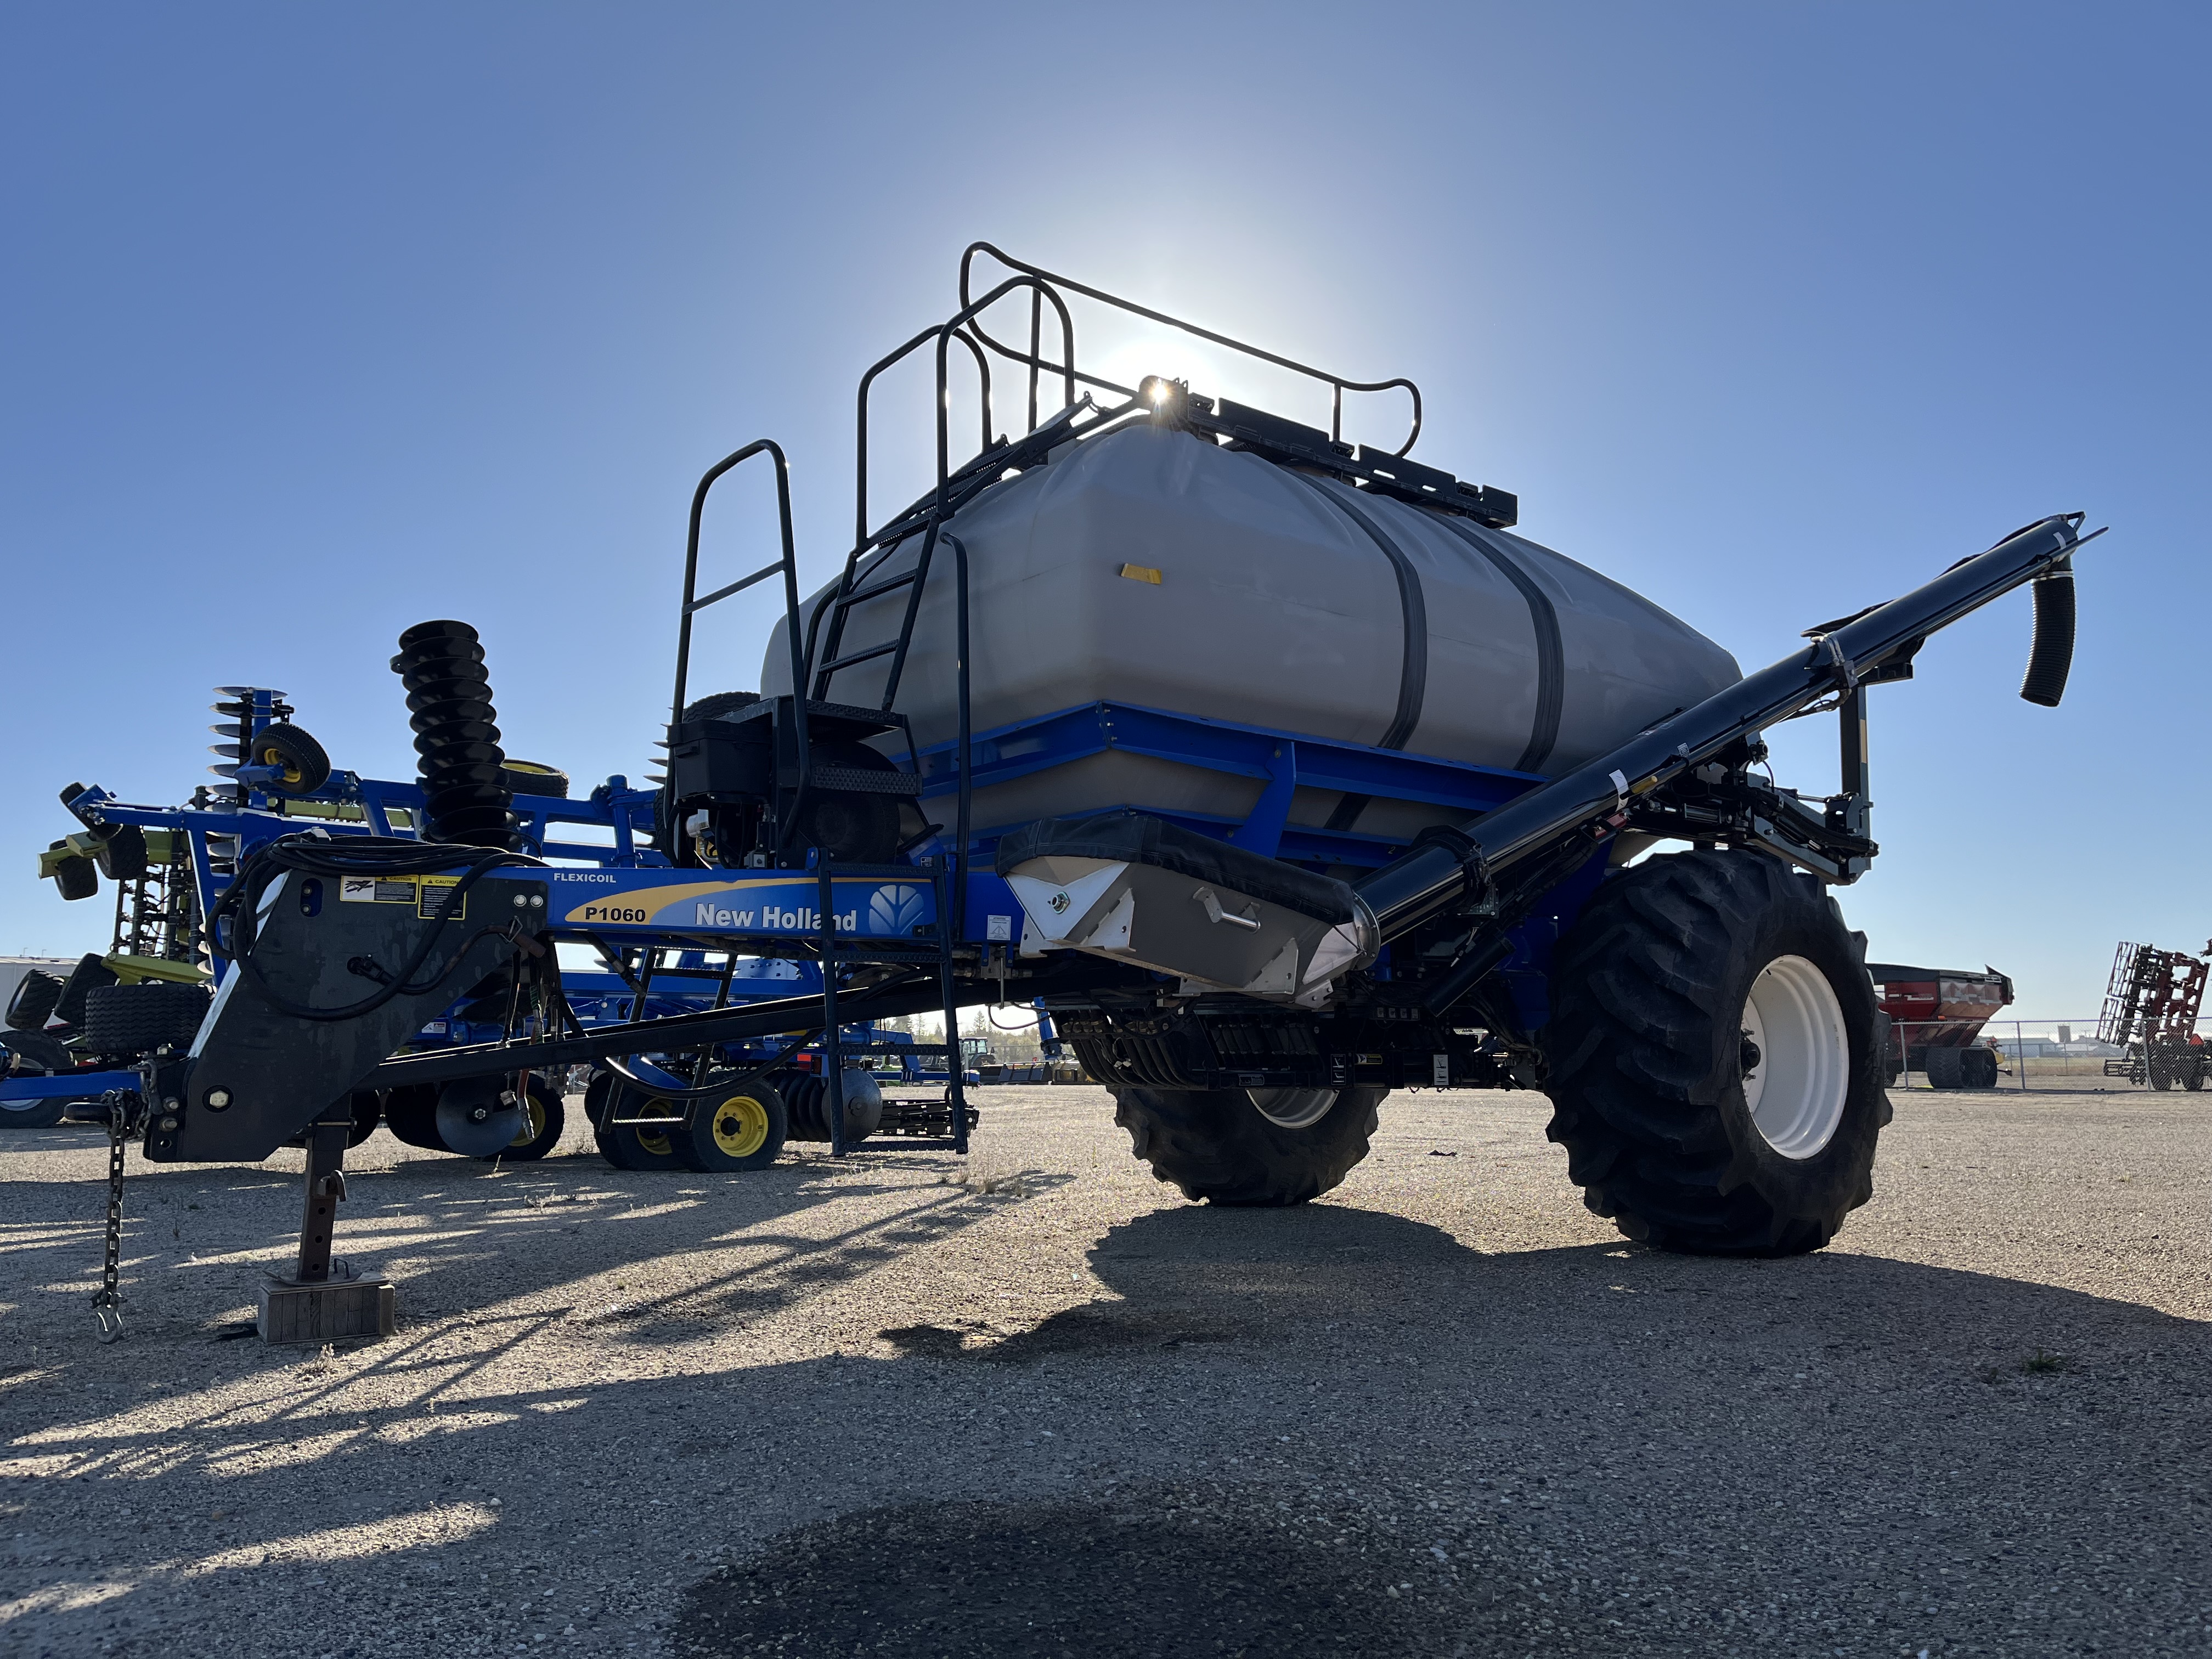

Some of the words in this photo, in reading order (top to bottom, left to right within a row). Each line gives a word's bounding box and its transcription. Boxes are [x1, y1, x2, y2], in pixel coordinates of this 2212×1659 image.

[554, 873, 617, 883] FLEXICOIL
[585, 907, 646, 922] P1060
[696, 903, 755, 927] New
